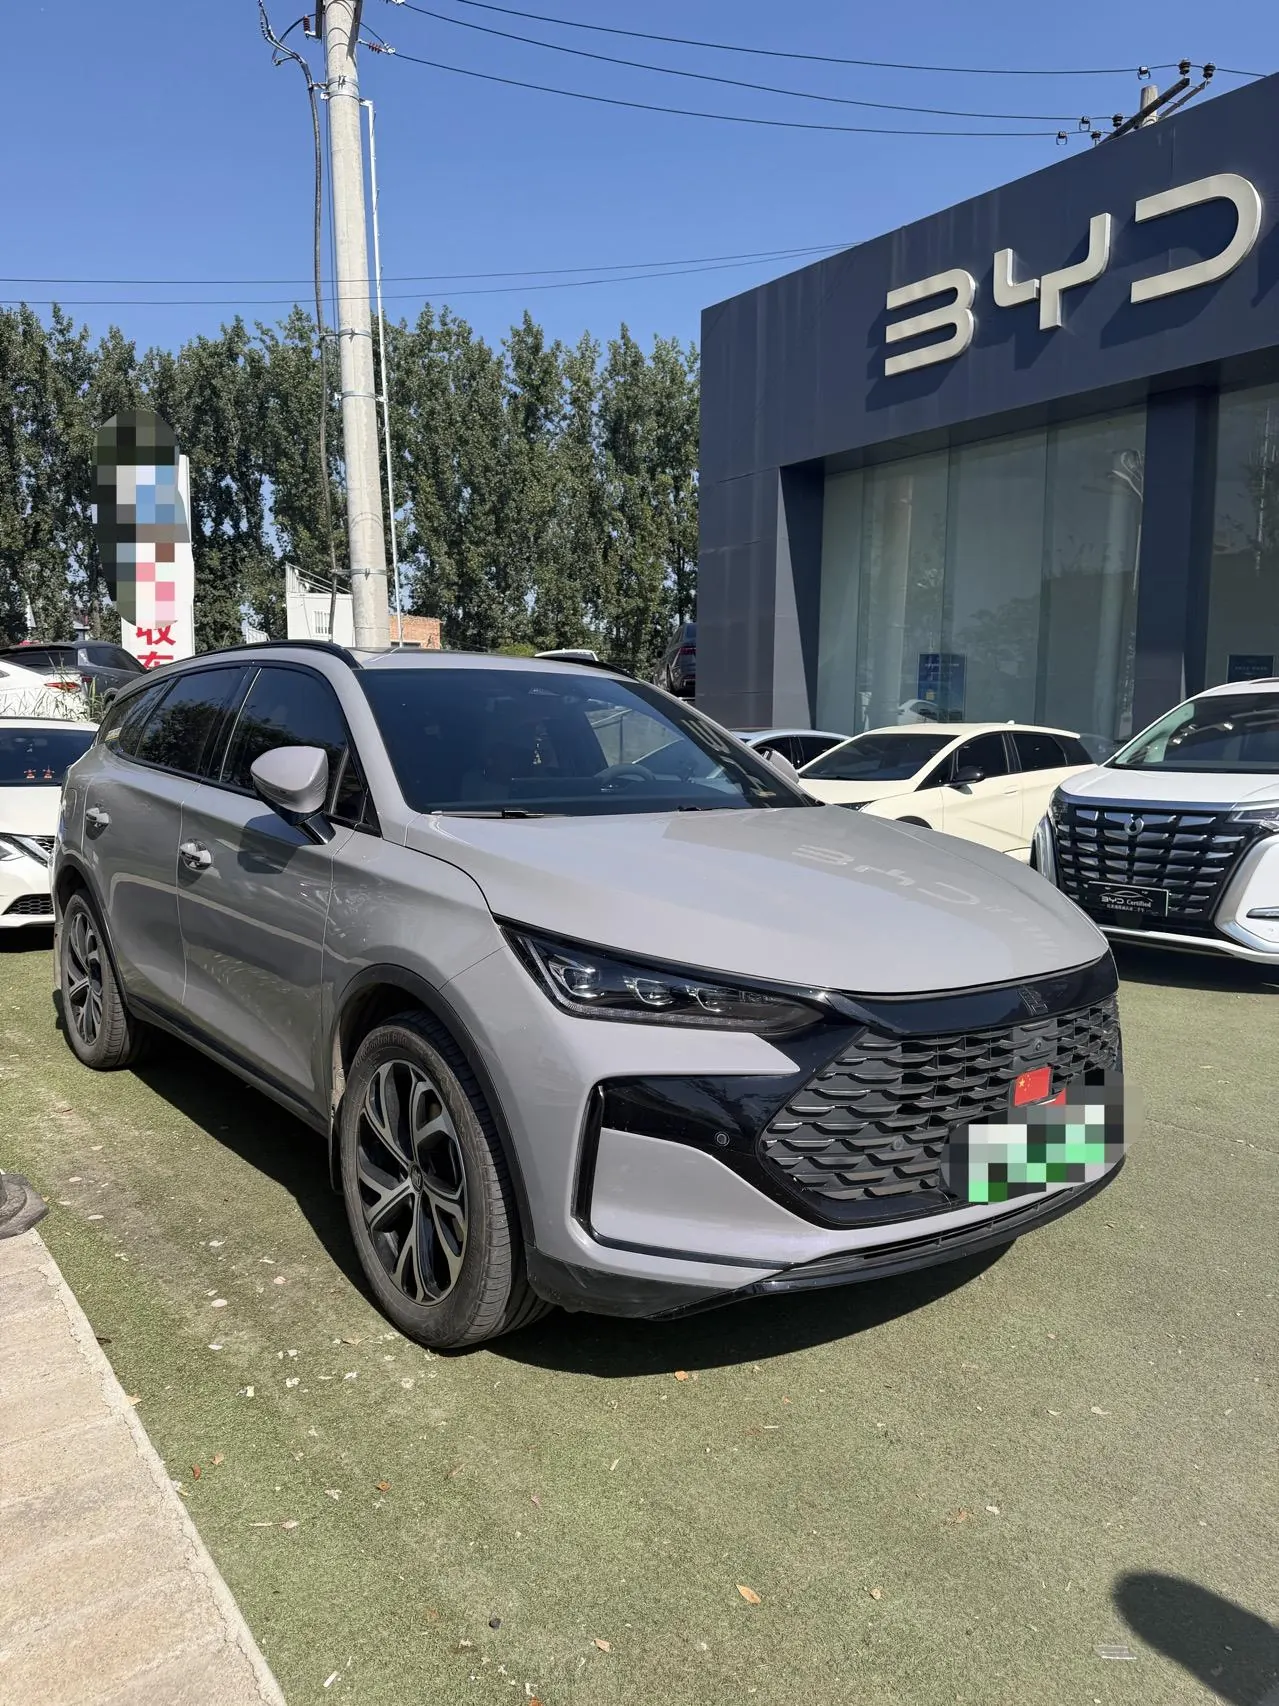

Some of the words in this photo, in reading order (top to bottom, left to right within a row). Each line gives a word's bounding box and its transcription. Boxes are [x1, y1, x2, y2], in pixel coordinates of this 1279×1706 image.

[885, 173, 1262, 377] BYD
[1101, 896, 1125, 904] BYD
[1126, 899, 1152, 908] Certified
